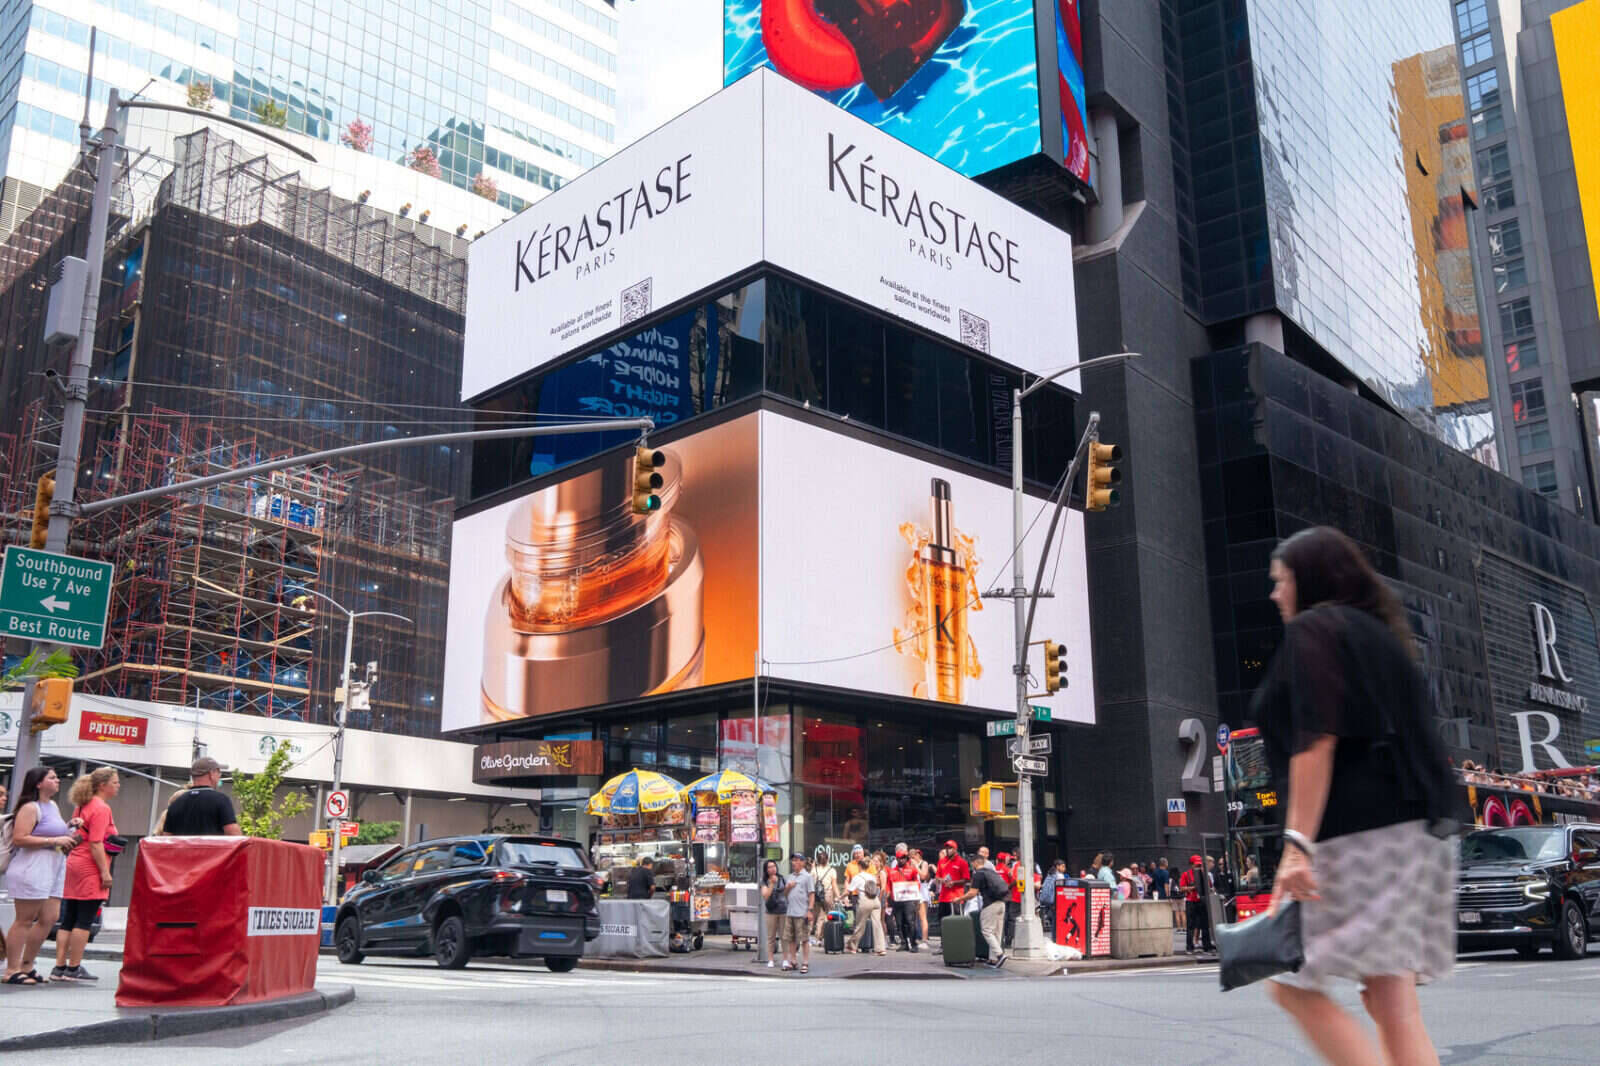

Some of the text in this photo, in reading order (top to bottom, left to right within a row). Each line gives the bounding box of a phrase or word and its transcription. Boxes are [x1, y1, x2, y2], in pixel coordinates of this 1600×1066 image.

[514, 153, 692, 293] KÉRASTASE
[828, 132, 1021, 284] KÉRASTASE
[575, 248, 616, 281] PARIS
[909, 238, 953, 271] PARIS
[880, 275, 951, 313] Available at the finest
[893, 294, 951, 324] salons worldwide
[550, 299, 613, 335] Available at the finest
[560, 311, 613, 341] salons worldwide
[16, 553, 103, 581] Southbound
[22, 572, 91, 596] Use 7 Ave
[9, 616, 91, 641] Best Route
[1528, 601, 1574, 683] R
[481, 753, 550, 771] Olive Garden
[1178, 718, 1210, 793] 2
